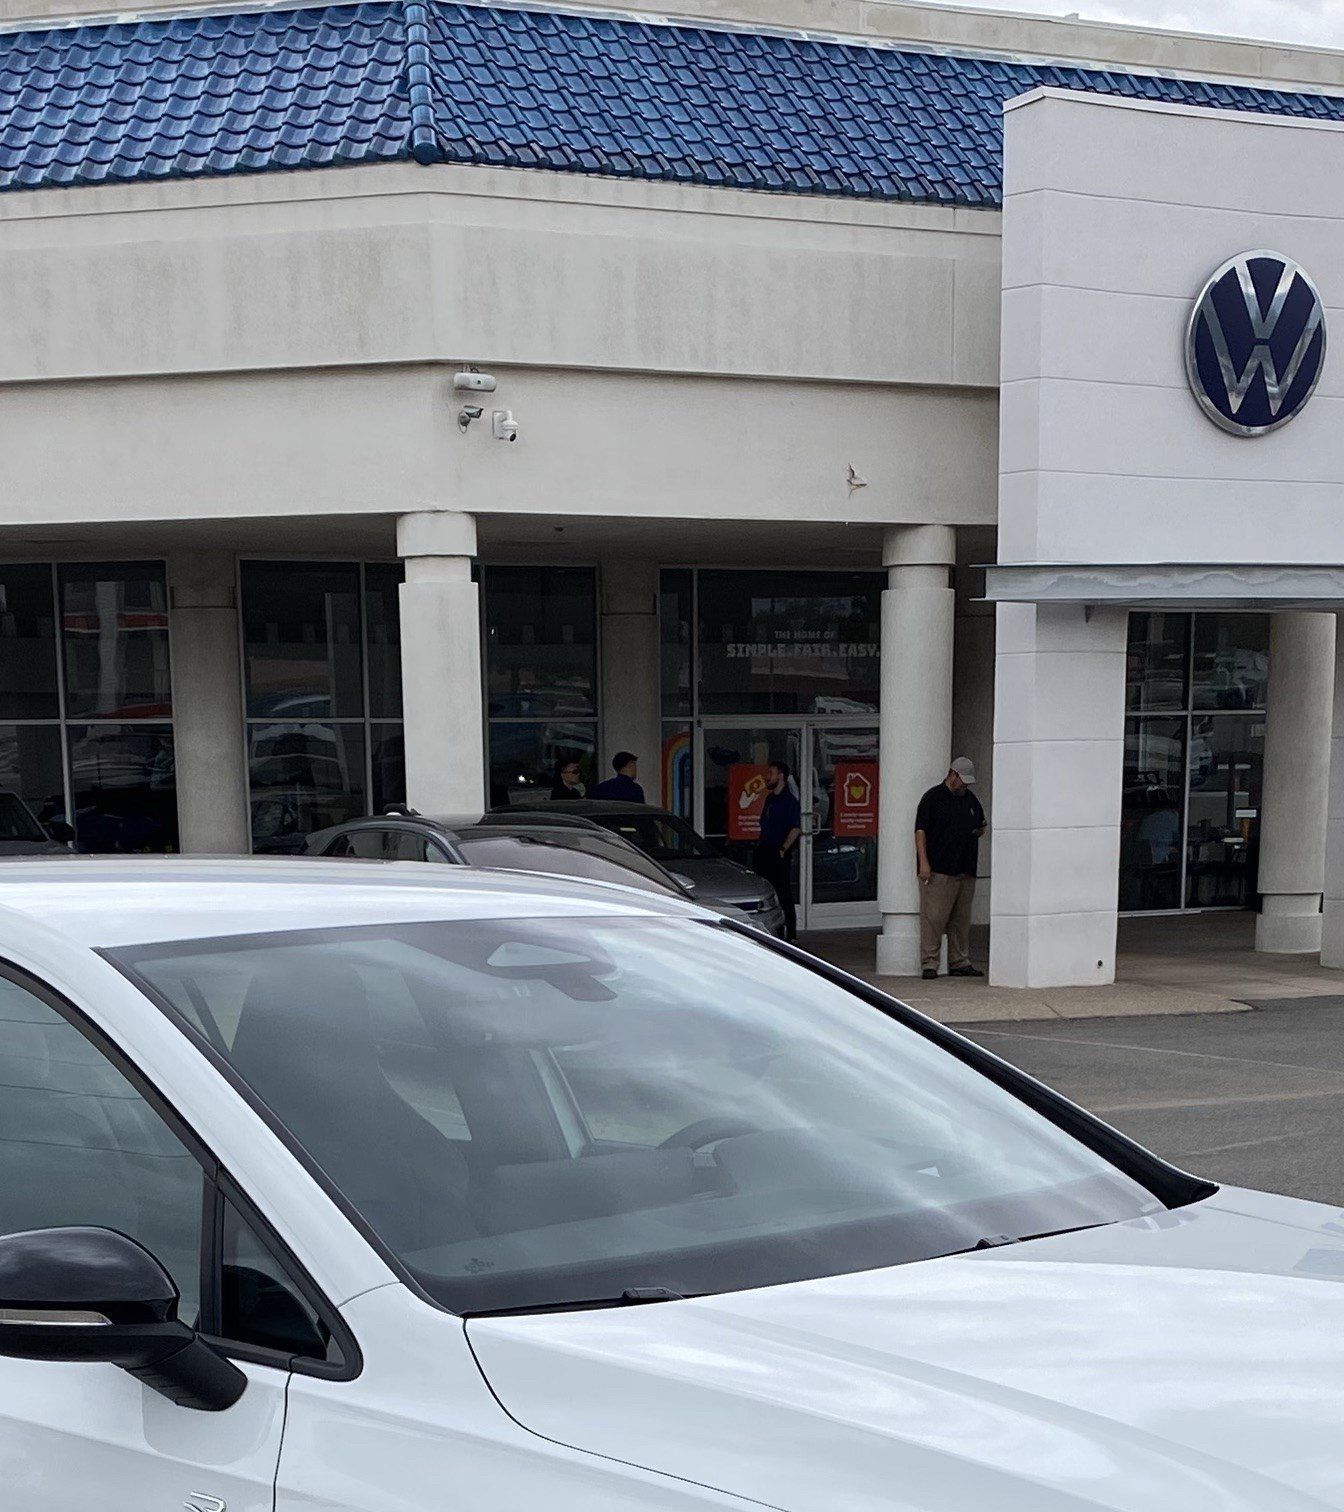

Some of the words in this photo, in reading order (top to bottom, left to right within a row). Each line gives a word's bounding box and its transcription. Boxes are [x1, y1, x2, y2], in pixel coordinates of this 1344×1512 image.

[774, 629, 791, 640] THE
[793, 629, 821, 640] HOME
[823, 629, 835, 640] OF
